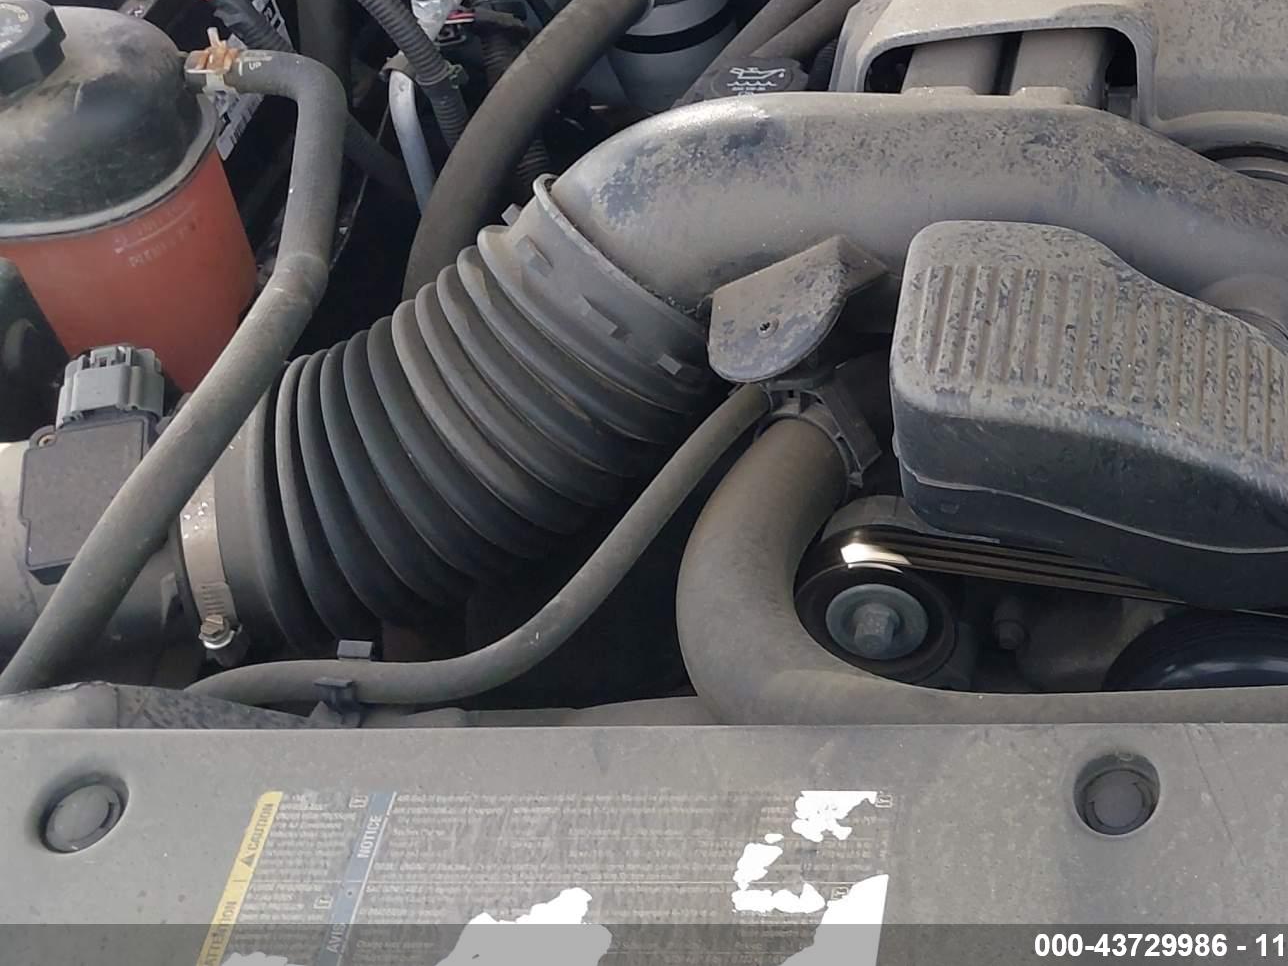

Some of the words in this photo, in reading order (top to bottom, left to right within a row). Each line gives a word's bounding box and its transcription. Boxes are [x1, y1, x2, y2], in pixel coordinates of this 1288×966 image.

[248, 61, 262, 70] UP
[247, 803, 274, 852] CAUTION
[356, 815, 382, 859] NOTICE
[204, 901, 238, 966] ATTENTION
[326, 922, 347, 954] AVIS
